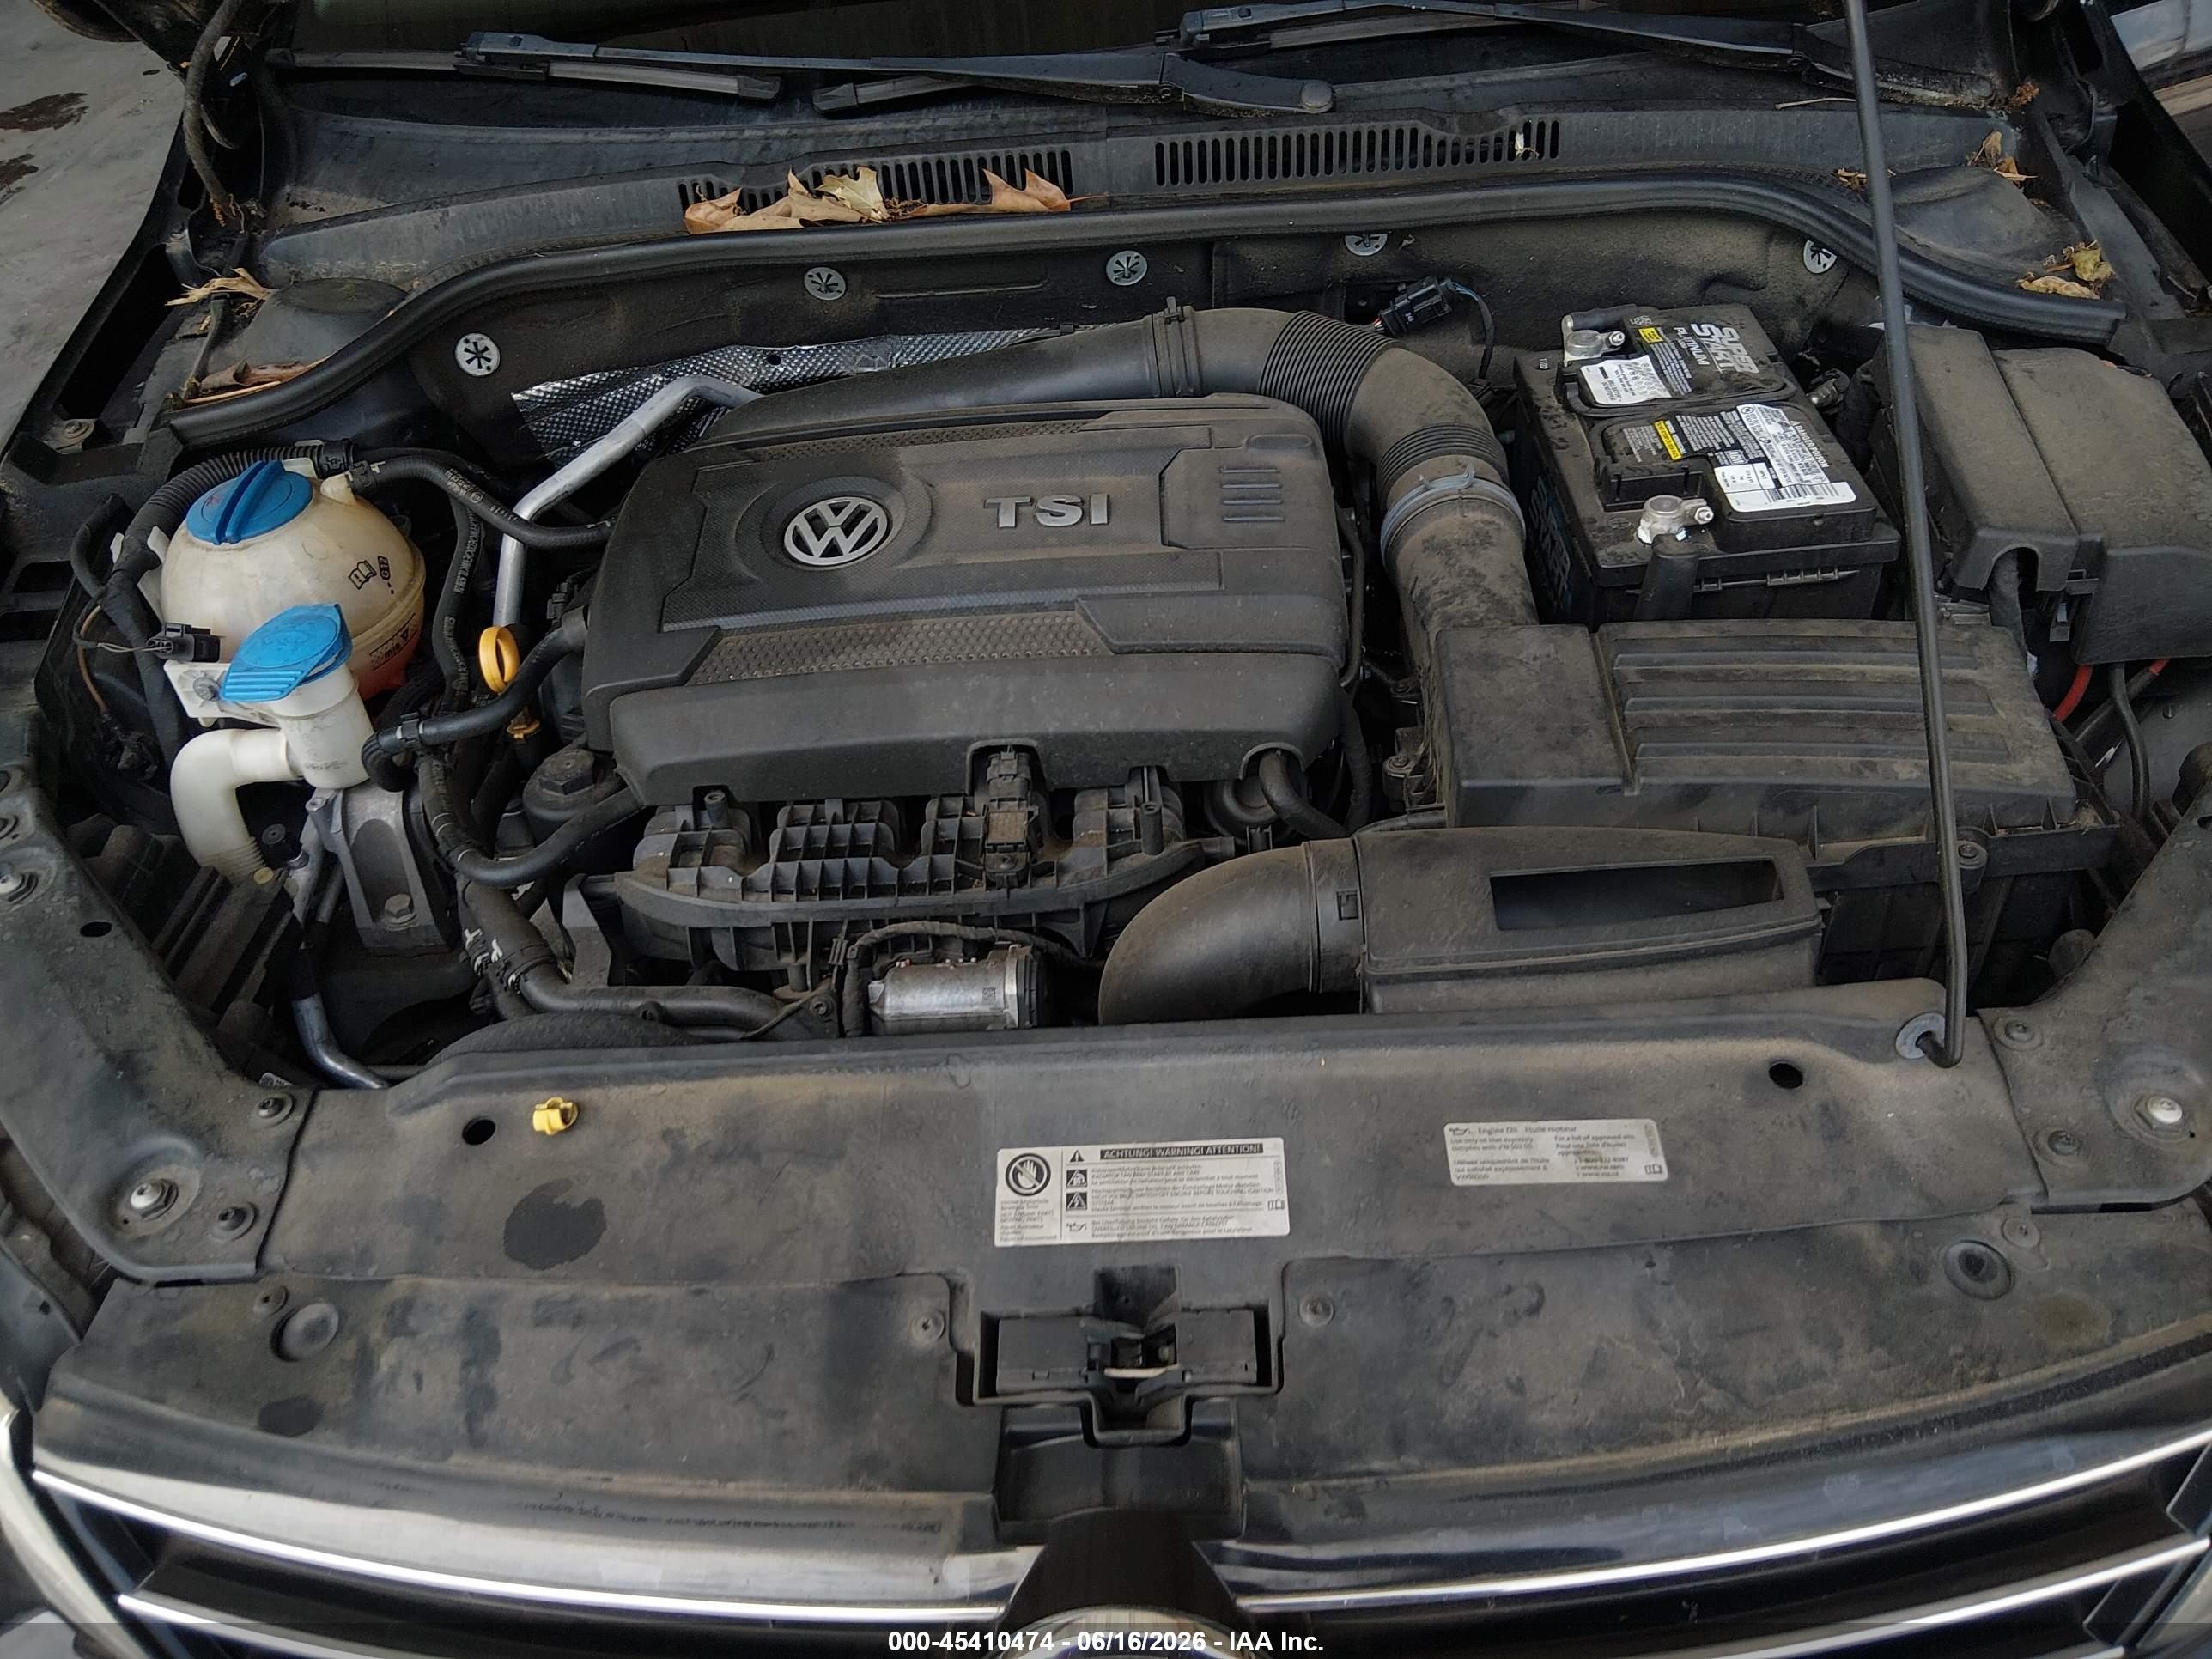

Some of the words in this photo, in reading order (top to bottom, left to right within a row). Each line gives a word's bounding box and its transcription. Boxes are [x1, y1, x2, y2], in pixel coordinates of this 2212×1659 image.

[1674, 326, 1711, 366] PLATINUM
[1690, 323, 1741, 374] START
[1720, 326, 1759, 374] SUPER
[985, 493, 1110, 528] TSI
[784, 496, 888, 566] VW
[384, 641, 401, 659] min
[1478, 1127, 1504, 1135] Engine
[1103, 1147, 1153, 1158] ACHTUNG!
[1155, 1146, 1204, 1158] WARNING!
[1206, 1144, 1261, 1156] ATTENTION!
